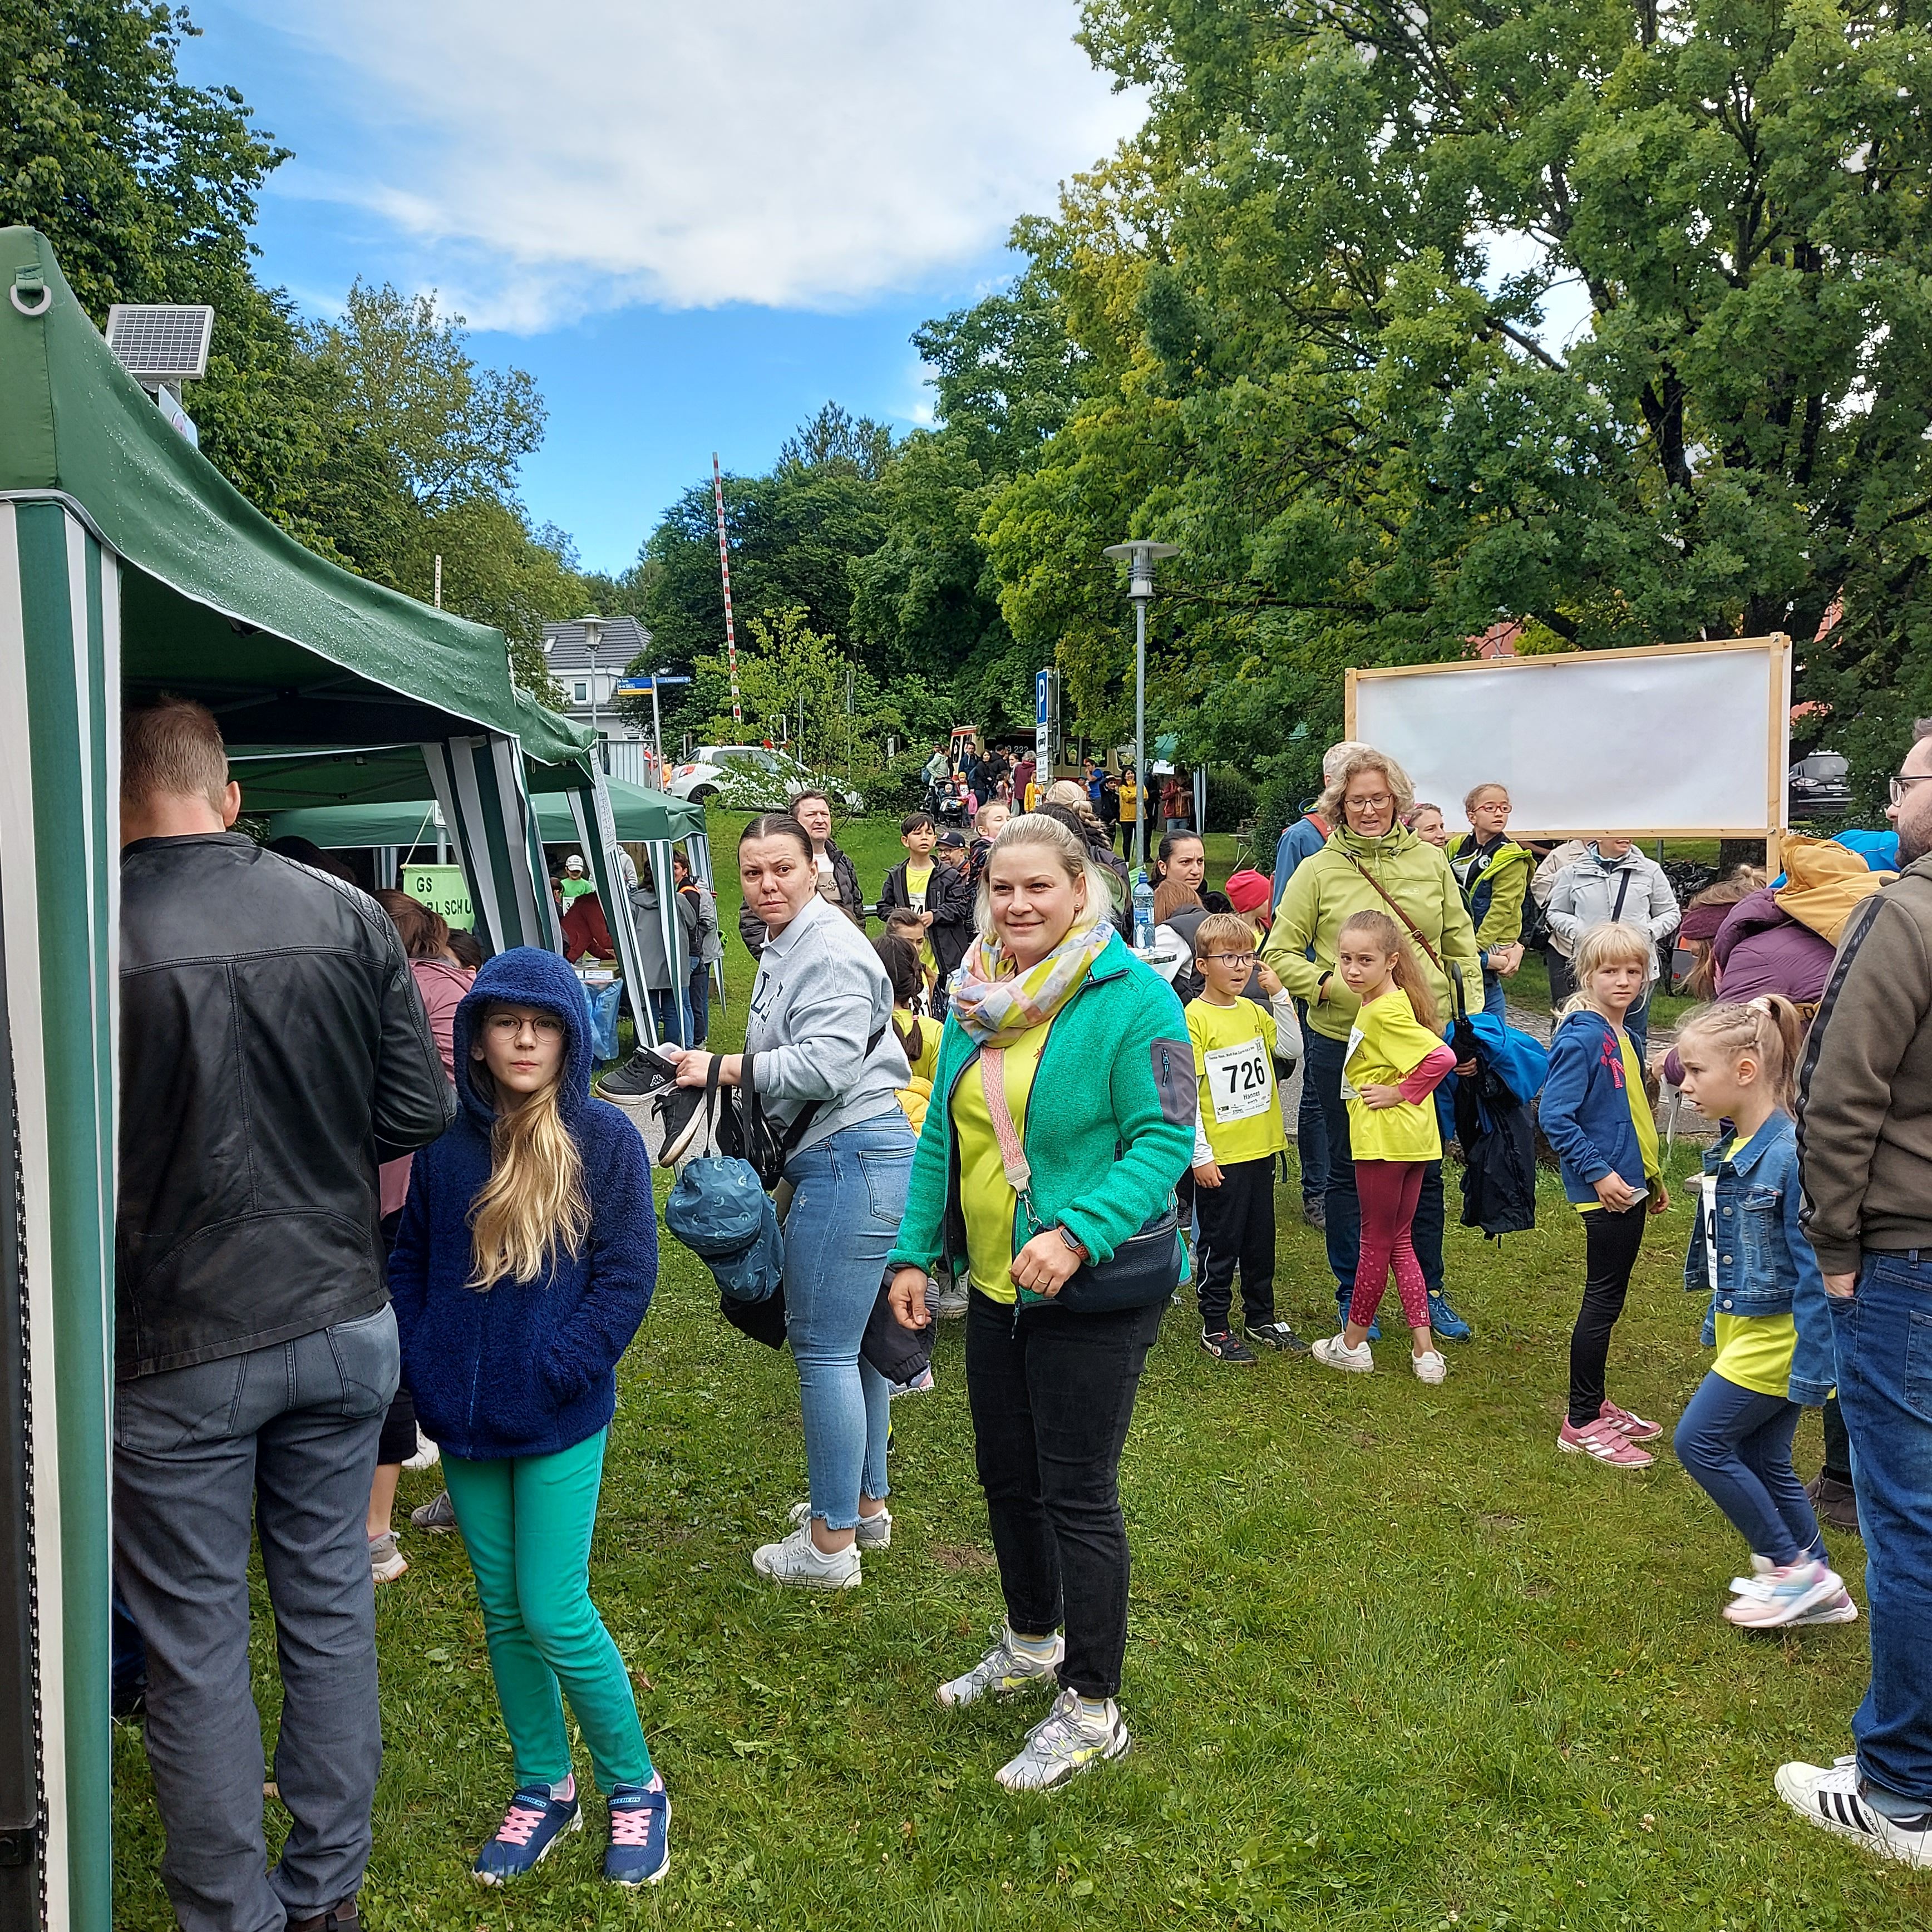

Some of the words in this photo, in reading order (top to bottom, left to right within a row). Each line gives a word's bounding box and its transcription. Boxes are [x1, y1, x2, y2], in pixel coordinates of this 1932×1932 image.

[1038, 678, 1046, 718] P
[416, 876, 432, 893] GS
[1222, 1057, 1265, 1094] 726
[516, 1795, 547, 1808] SKECHERS
[609, 1797, 641, 1806] SKECHERS
[1863, 1810, 1880, 1834] adidas
